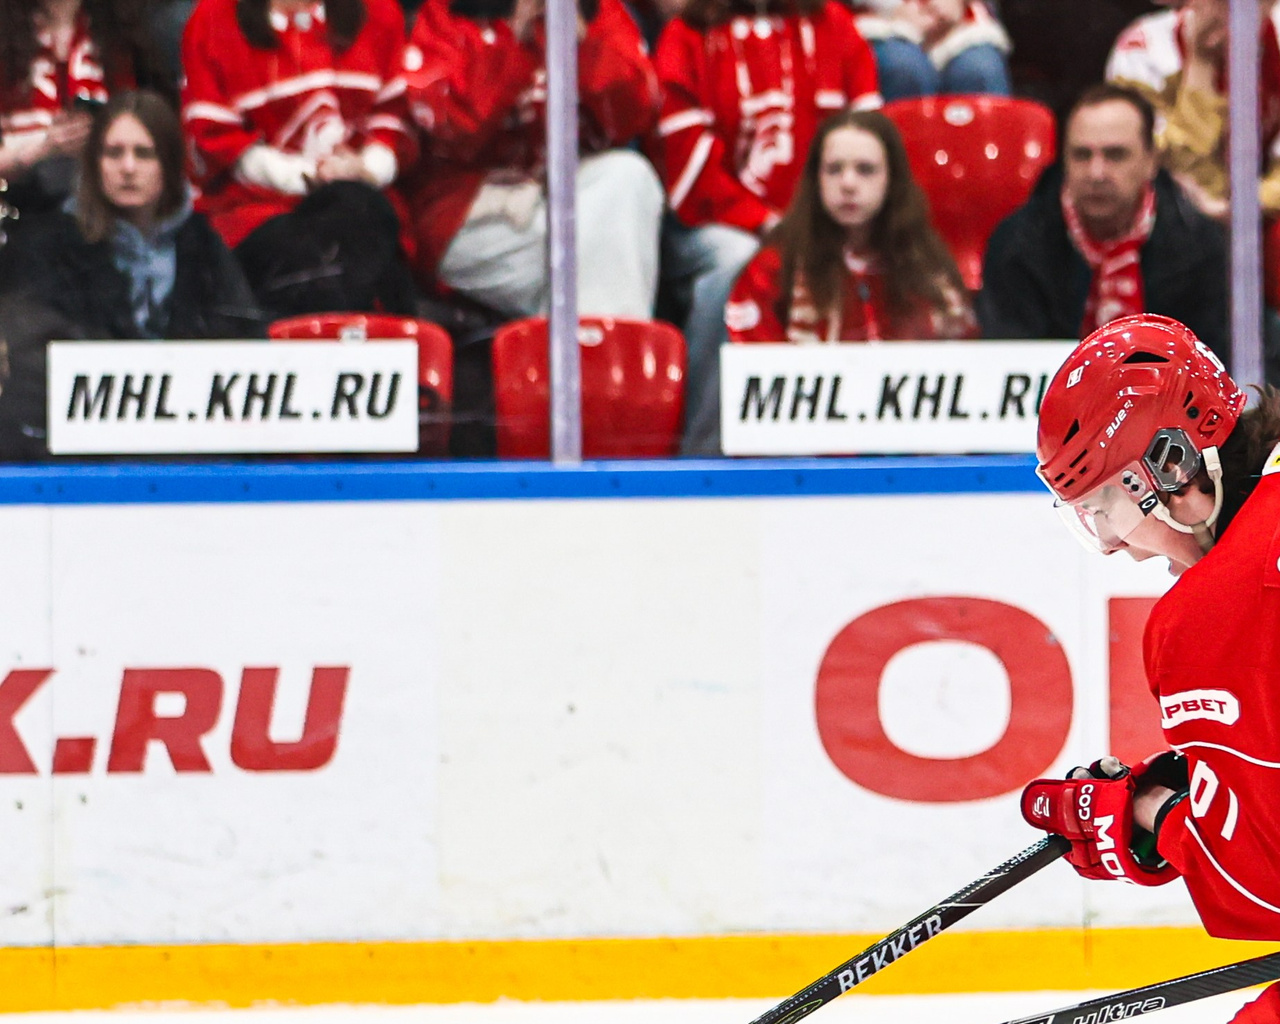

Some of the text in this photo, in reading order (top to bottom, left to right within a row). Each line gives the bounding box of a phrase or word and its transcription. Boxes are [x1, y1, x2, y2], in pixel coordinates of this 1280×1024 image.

[66, 372, 402, 421] MHL.KHL.RU
[1163, 698, 1227, 720] PBET
[837, 914, 943, 994] REKKER
